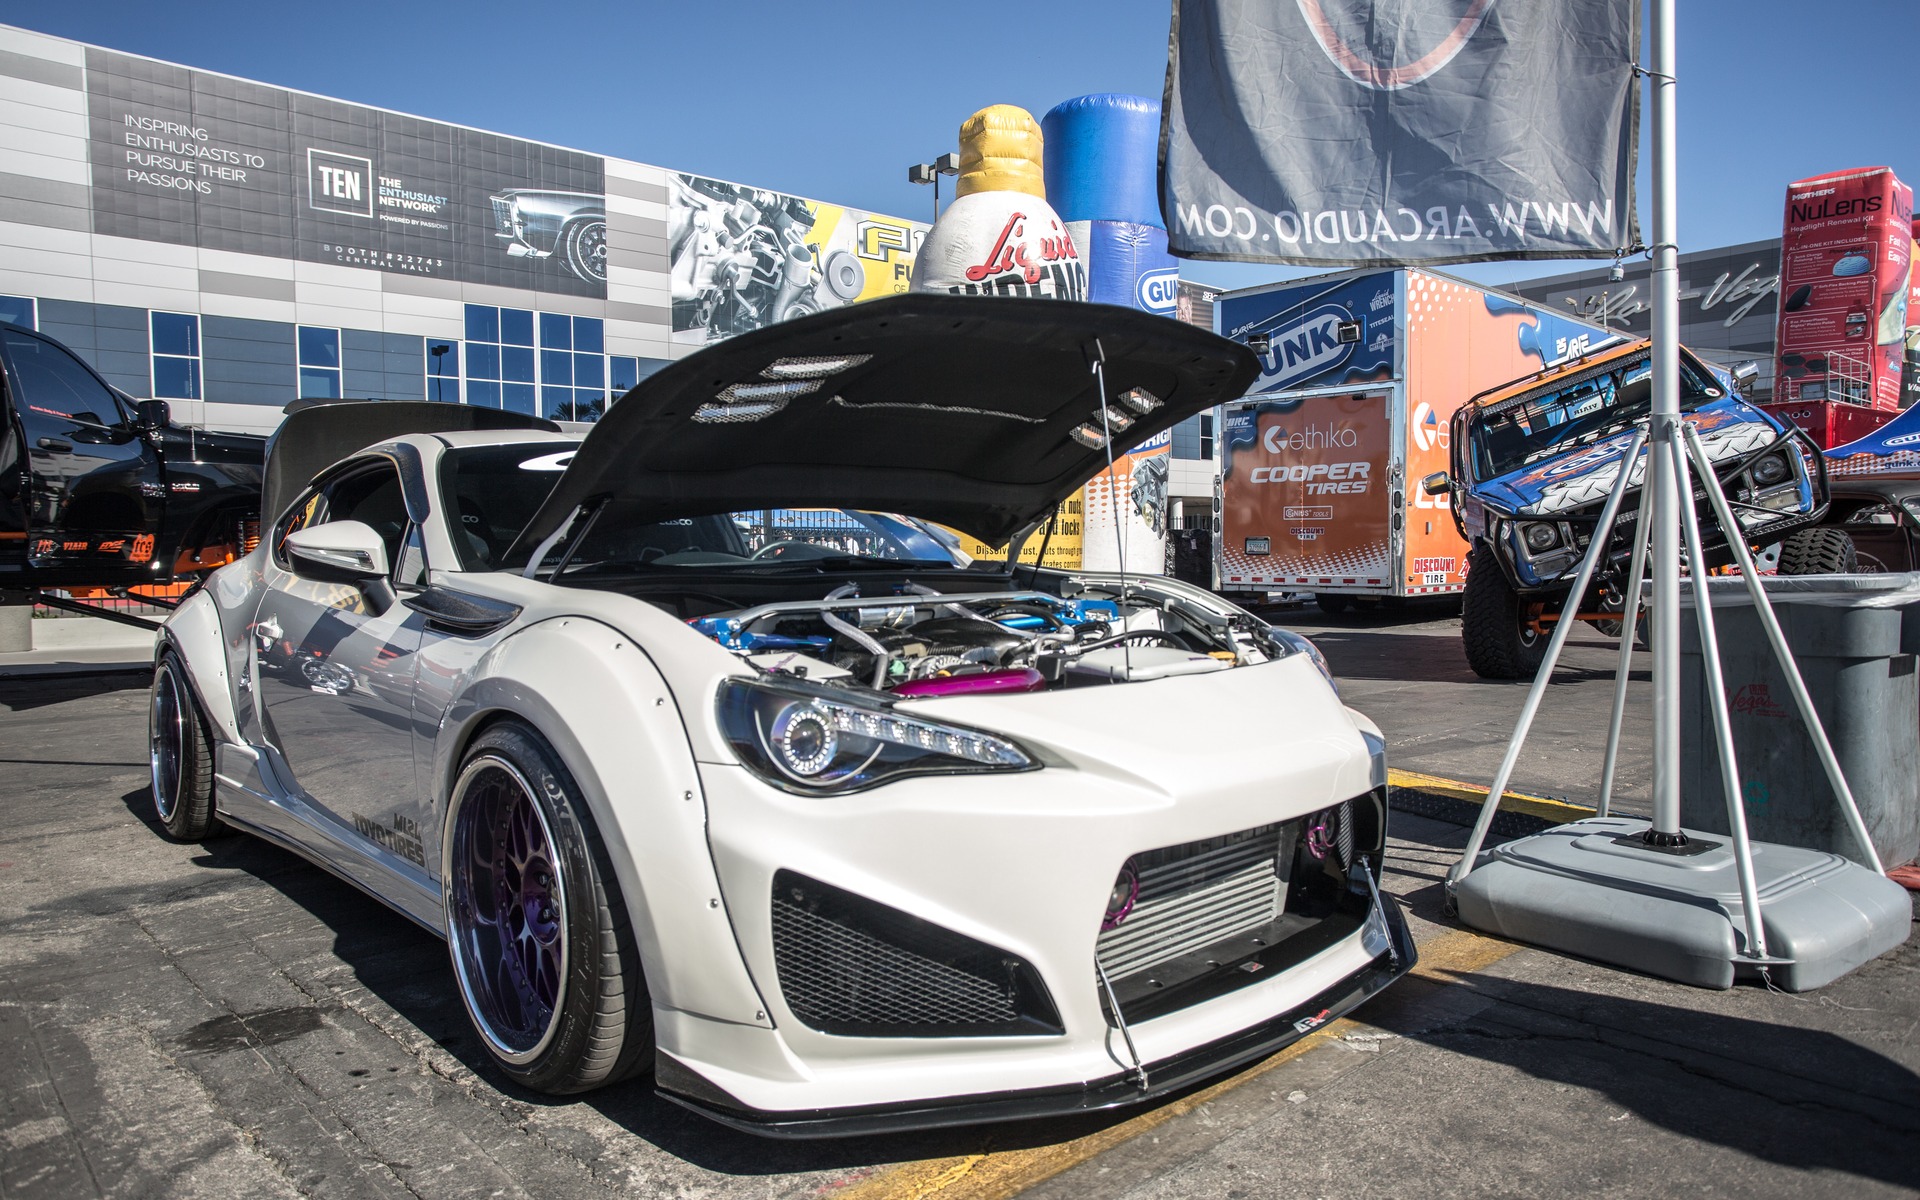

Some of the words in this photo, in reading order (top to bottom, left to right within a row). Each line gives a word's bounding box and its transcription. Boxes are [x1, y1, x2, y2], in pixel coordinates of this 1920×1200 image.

[124, 114, 209, 141] INSPIRING
[125, 132, 240, 164] ENTHUSIASTS
[243, 153, 265, 168] TO
[126, 151, 196, 174] PURSUE
[200, 163, 247, 183] THEIR
[127, 169, 212, 195] PASSIONS
[318, 165, 361, 201] TEN
[378, 176, 402, 189] THE
[378, 186, 448, 206] ENTHUSIAST
[1791, 187, 1836, 201] MOTHERS
[1790, 195, 1883, 224] NuLens
[379, 214, 411, 225] POWERED
[420, 220, 449, 230] PASSIONS
[1790, 221, 1825, 233] Headlight
[1827, 217, 1861, 227] Renewal
[323, 244, 378, 258] BOOTH
[386, 253, 443, 267] #22743
[965, 211, 1078, 284] Liquid
[337, 255, 393, 268] CENTRAL
[401, 263, 431, 273] HALL
[1369, 293, 1395, 312] WRENCH
[1254, 319, 1341, 383] UNK
[1289, 422, 1357, 450] ethika
[1250, 461, 1371, 484] COOPER
[1305, 480, 1368, 495] TIRES
[1061, 518, 1080, 536] locks
[1290, 527, 1325, 535] DISCOUNT
[63, 541, 89, 551] VIAIR
[1020, 546, 1038, 557] ust,
[1413, 557, 1456, 574] DISCOUNT
[1425, 574, 1445, 584] TIRE
[351, 811, 387, 846] TOYO
[384, 828, 426, 868] TIRES
